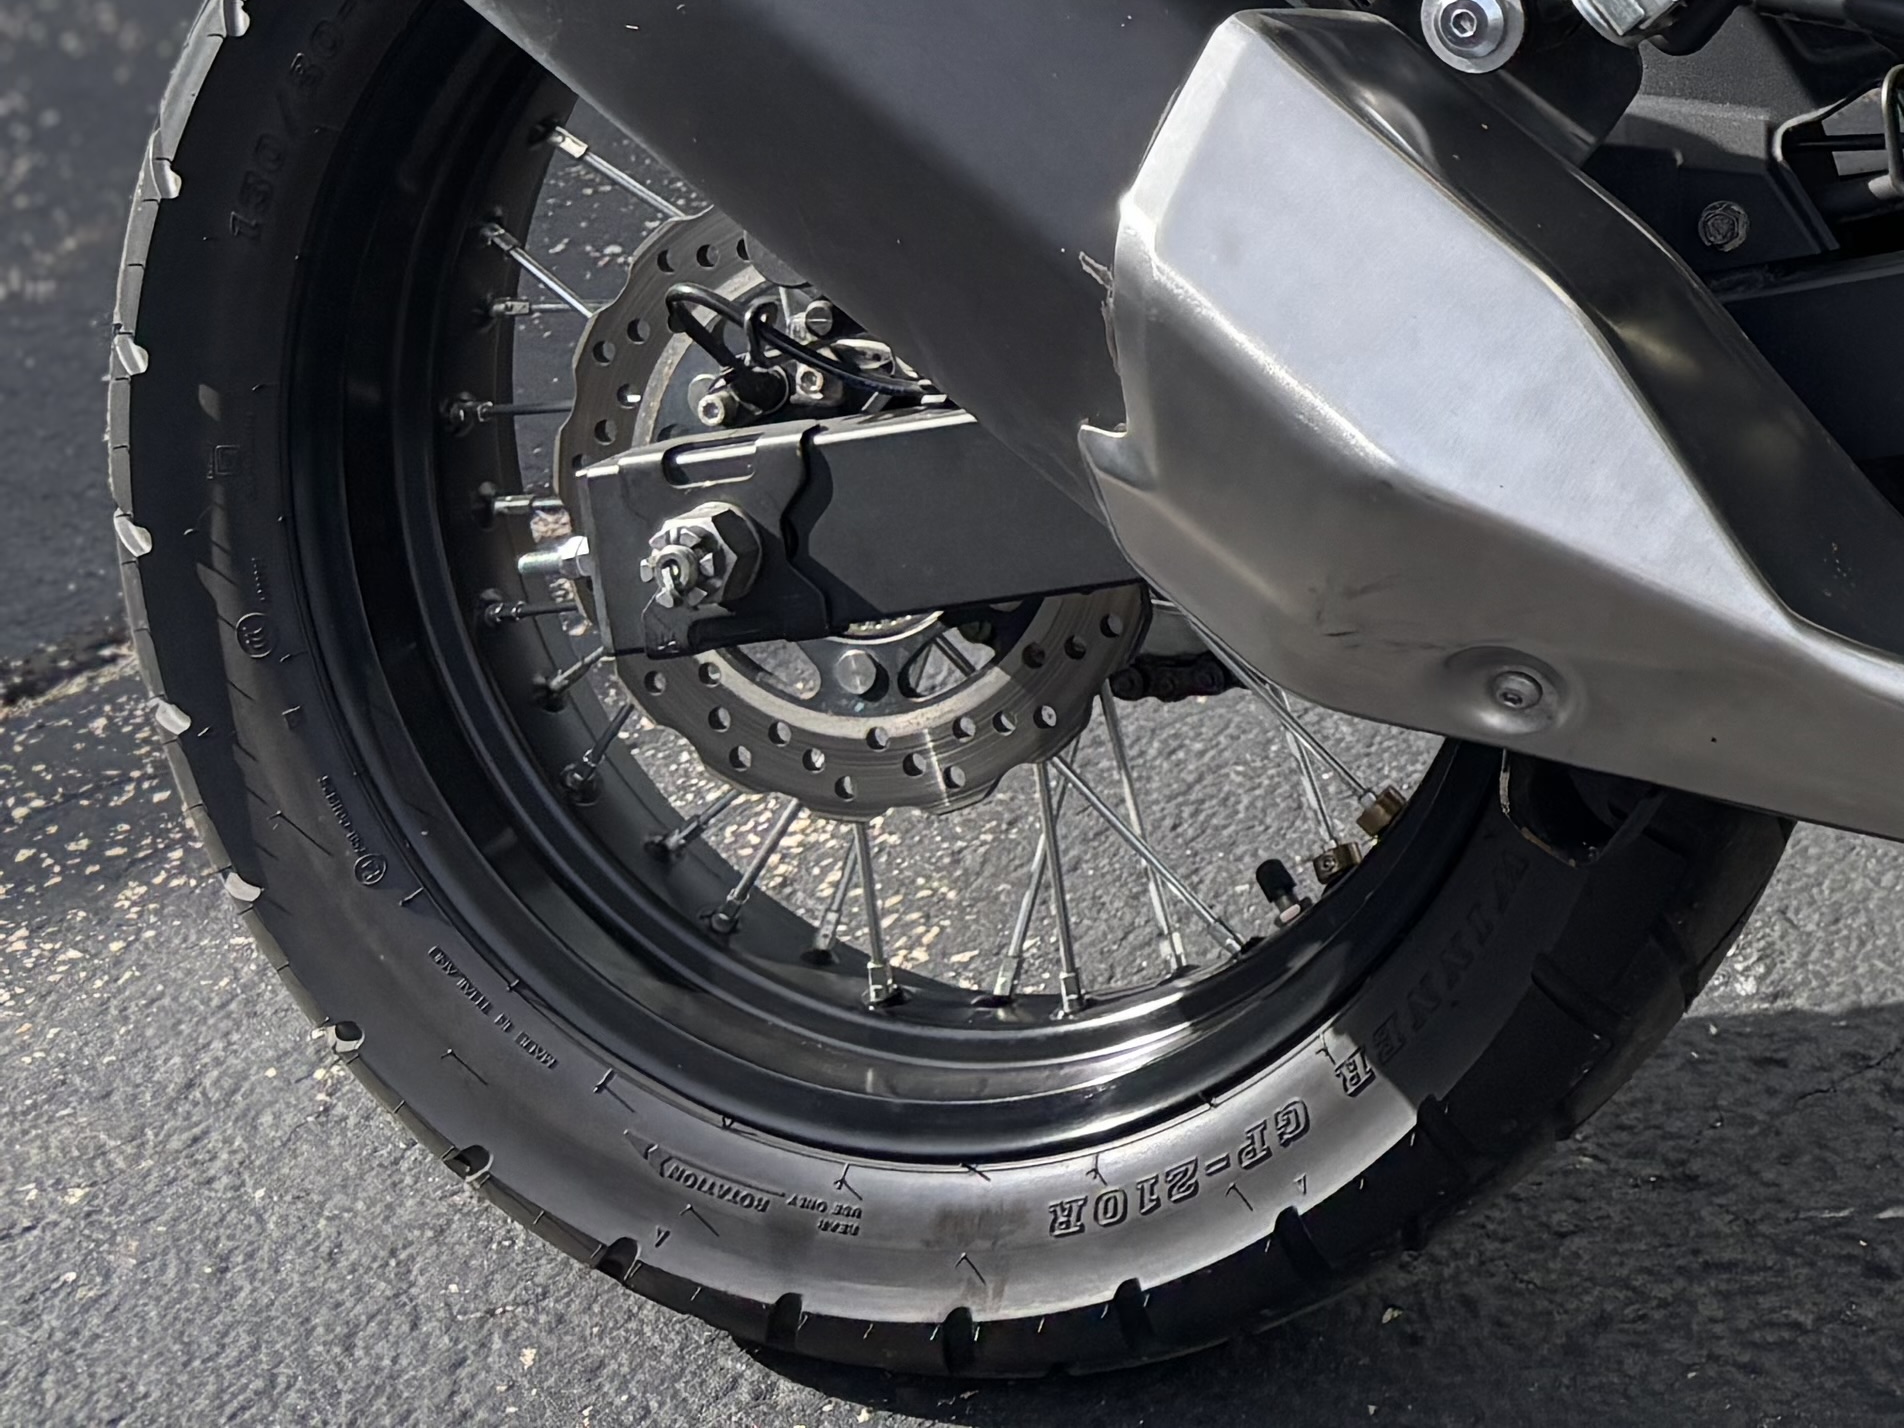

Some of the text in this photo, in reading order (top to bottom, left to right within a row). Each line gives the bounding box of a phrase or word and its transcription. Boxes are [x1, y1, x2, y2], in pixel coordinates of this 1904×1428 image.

[1047, 850, 1530, 1240] WINNER GP-210R
[667, 1163, 770, 1213] ROTATION
